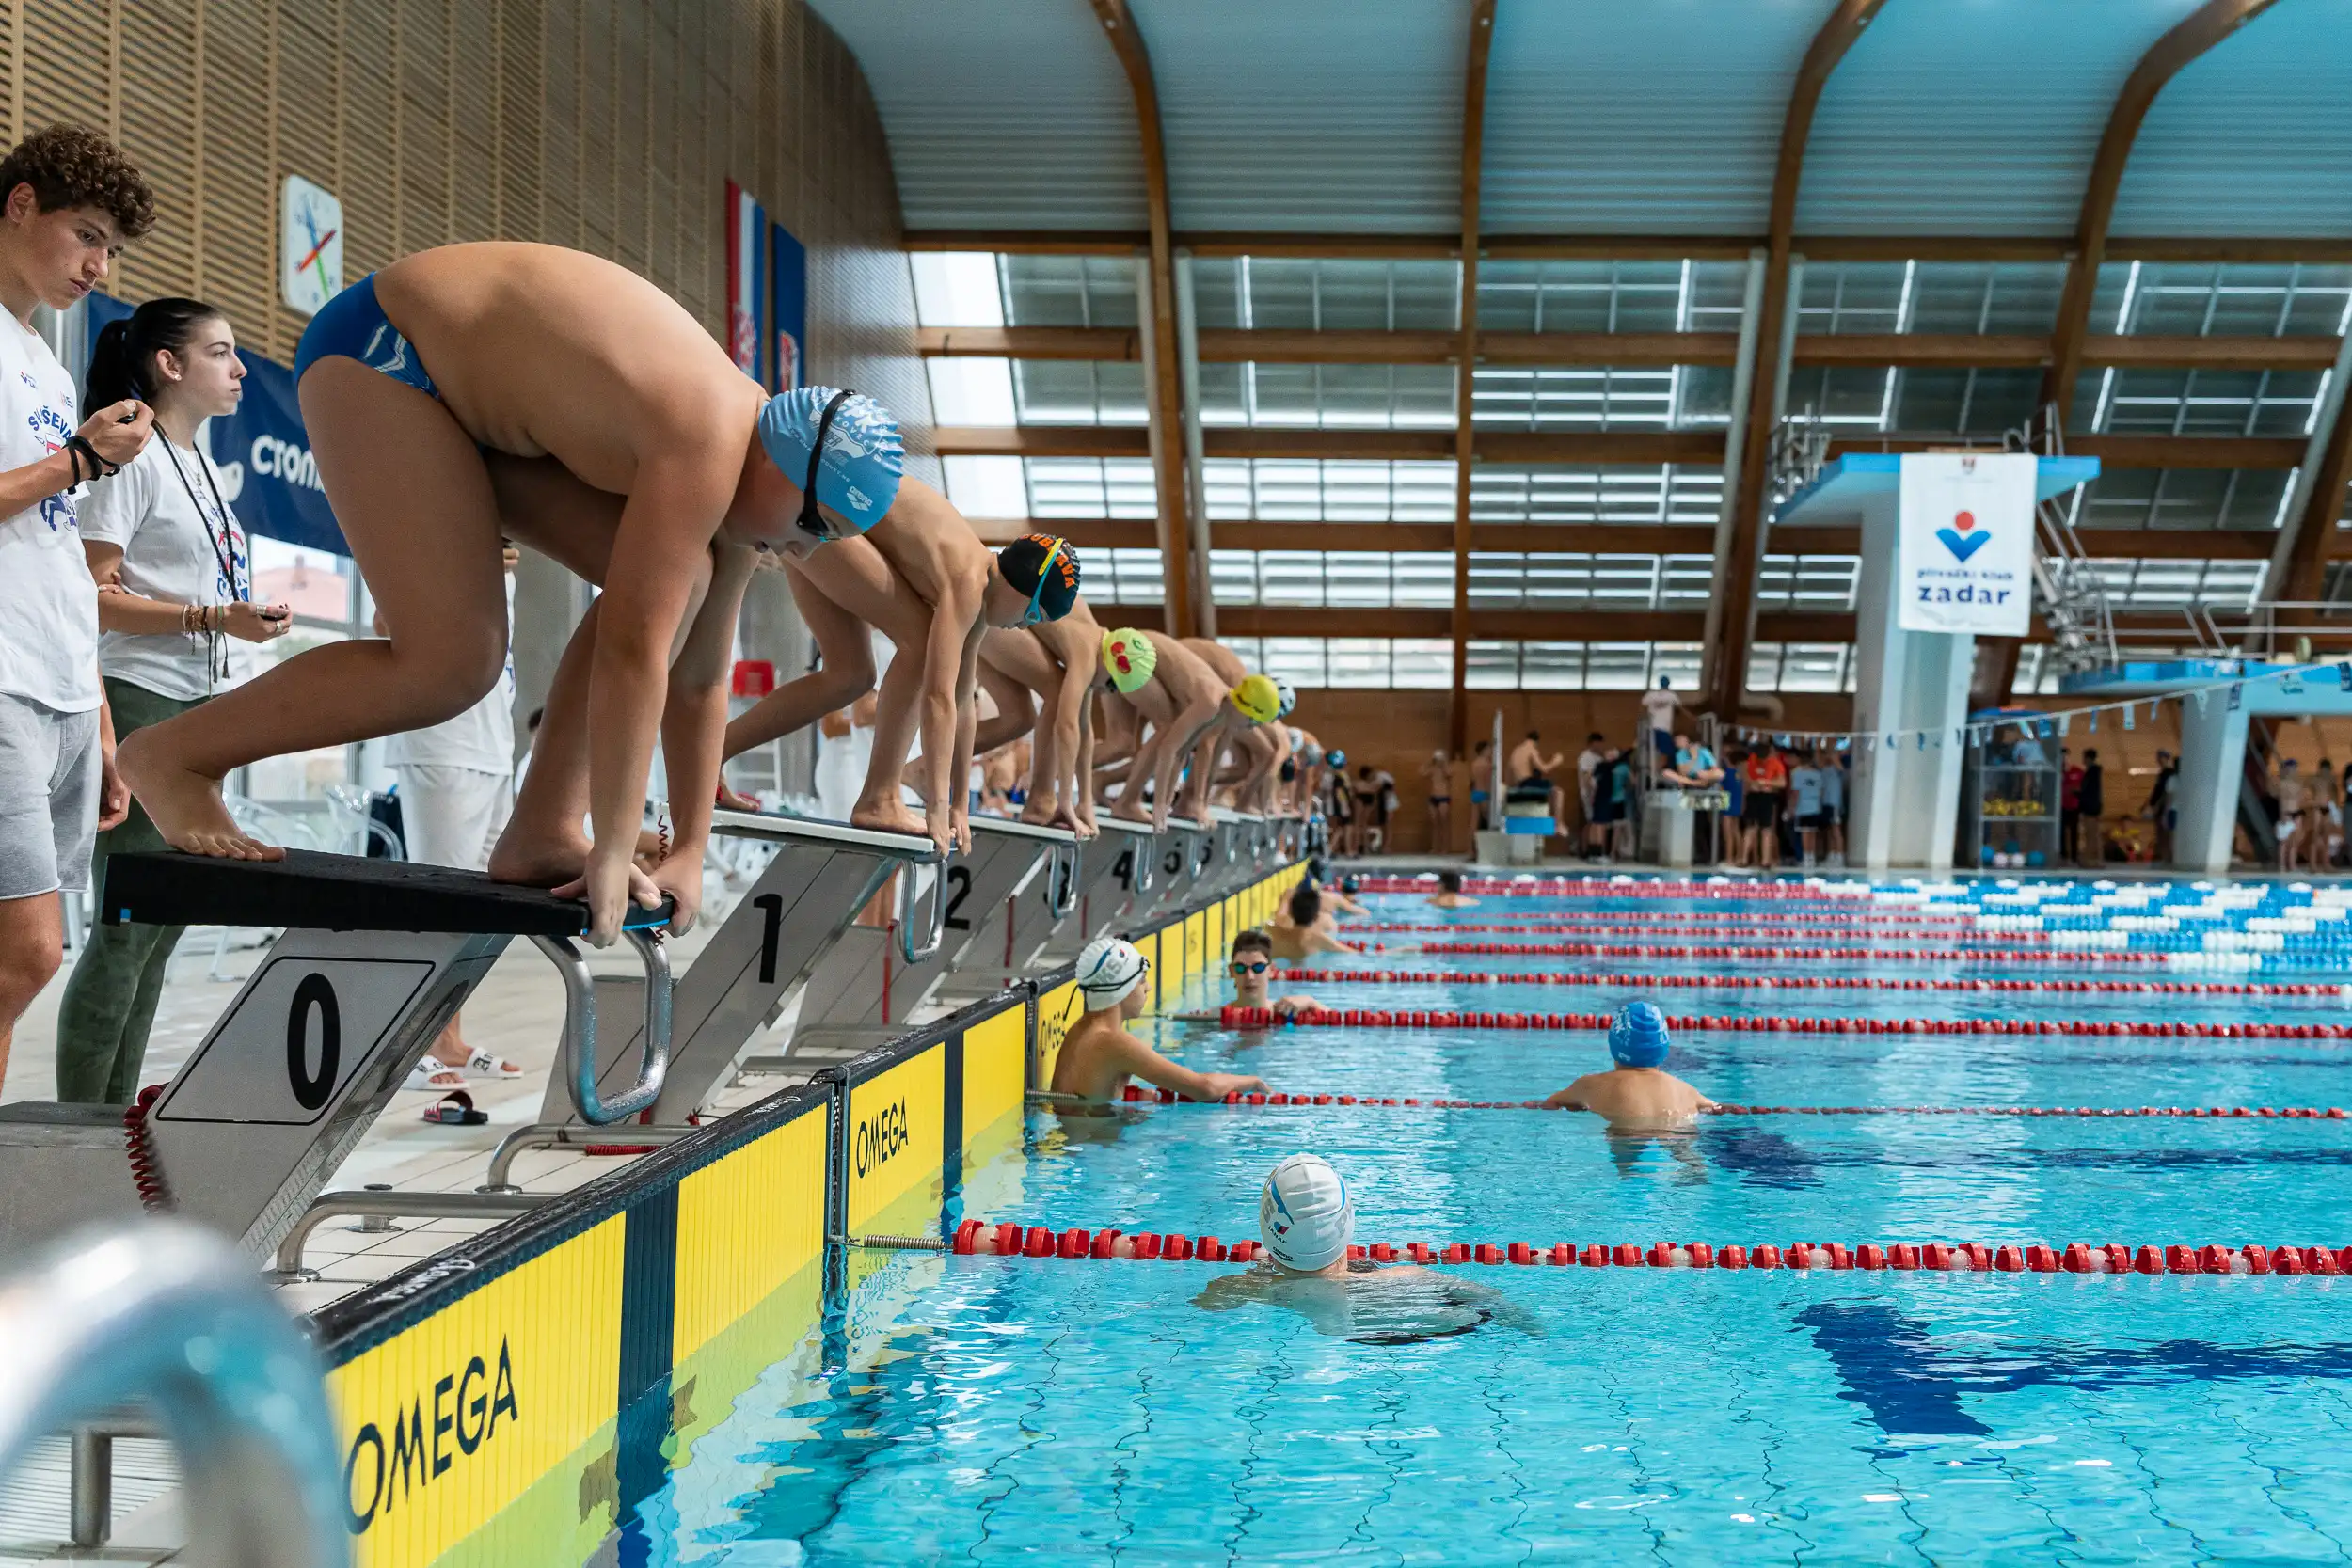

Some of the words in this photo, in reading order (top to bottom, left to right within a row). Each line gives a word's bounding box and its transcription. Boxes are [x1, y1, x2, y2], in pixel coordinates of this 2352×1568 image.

[834, 414, 871, 448] KOVEC
[251, 435, 324, 492] crom
[849, 485, 873, 507] arena
[1918, 584, 2011, 605] zadar
[944, 865, 971, 931] 2
[1112, 850, 1133, 891] 4
[754, 893, 783, 984] 1
[287, 972, 341, 1111] 0
[856, 1095, 909, 1179] OMEGA
[343, 1332, 518, 1536] OMEGA
